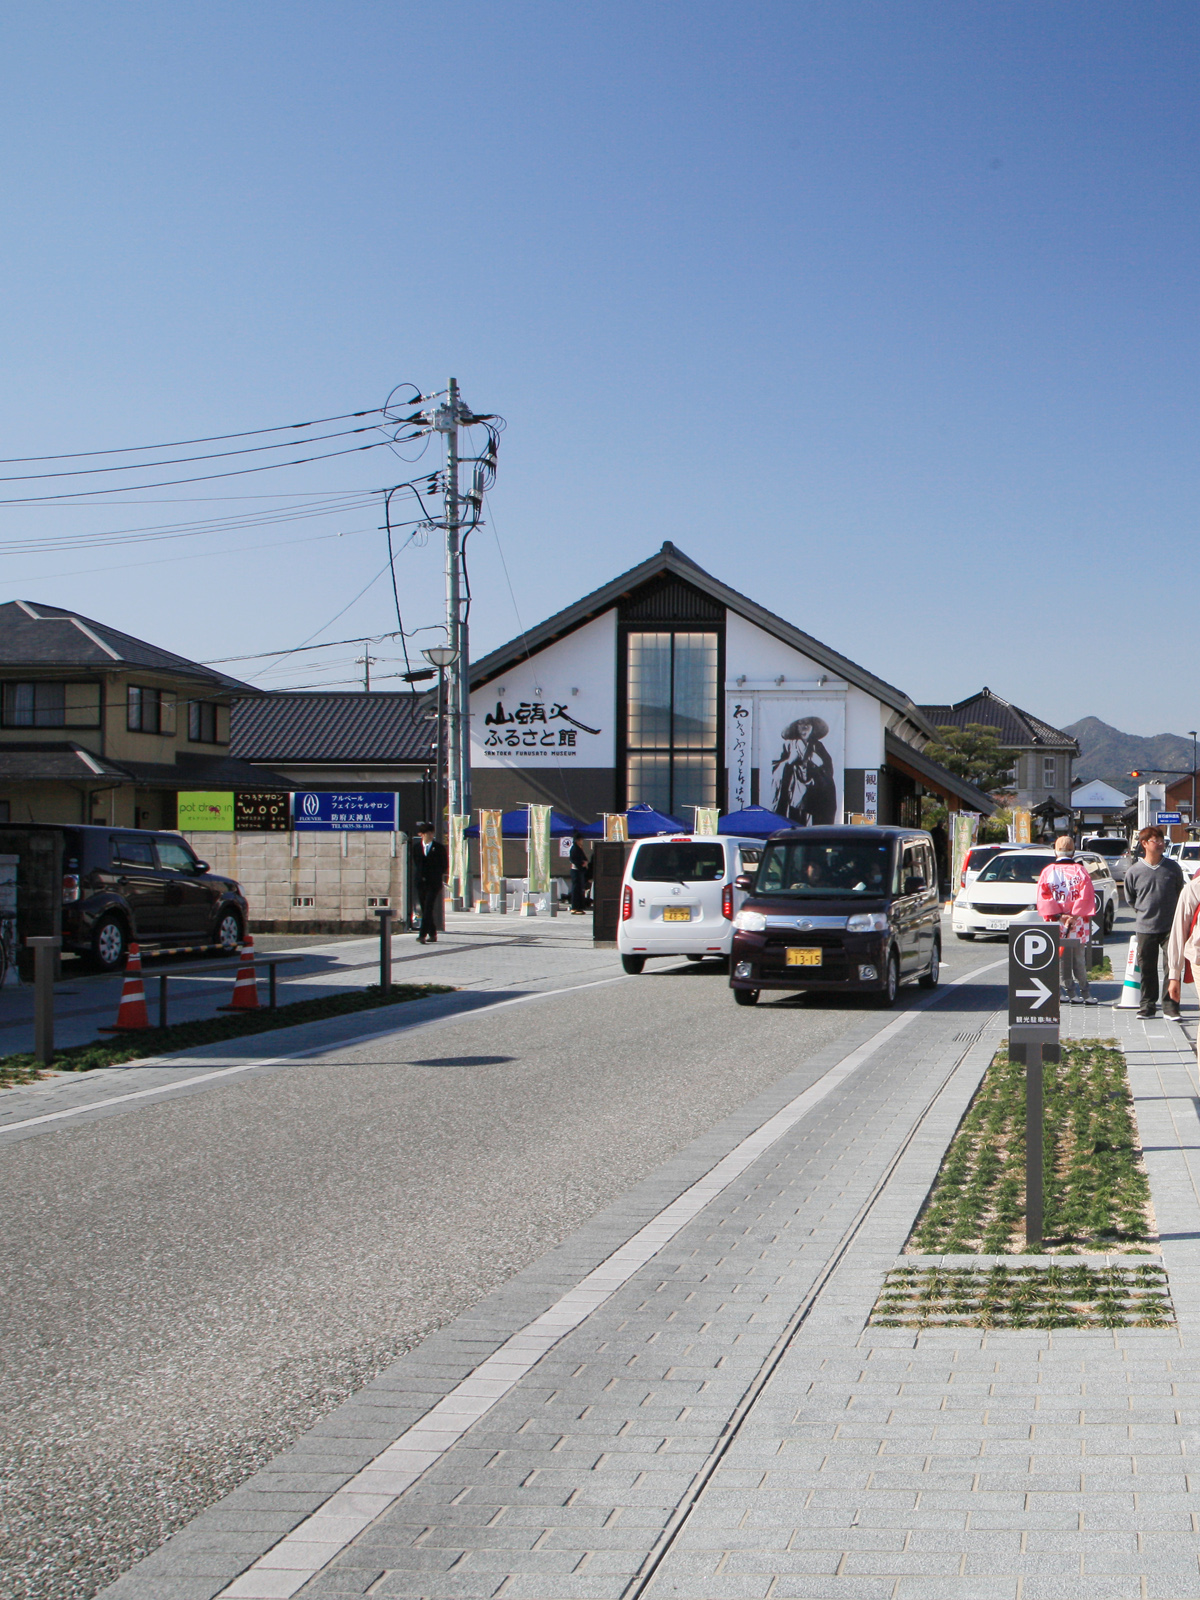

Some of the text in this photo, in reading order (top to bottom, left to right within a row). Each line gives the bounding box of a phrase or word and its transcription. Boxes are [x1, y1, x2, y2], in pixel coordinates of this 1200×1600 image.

[484, 701, 602, 735] 山頭火
[484, 728, 578, 747] ふるさと館
[179, 803, 196, 814] pot
[224, 803, 233, 812] in
[331, 814, 372, 822] 防府天神店
[1024, 935, 1048, 965] P
[795, 955, 821, 965] 13-15
